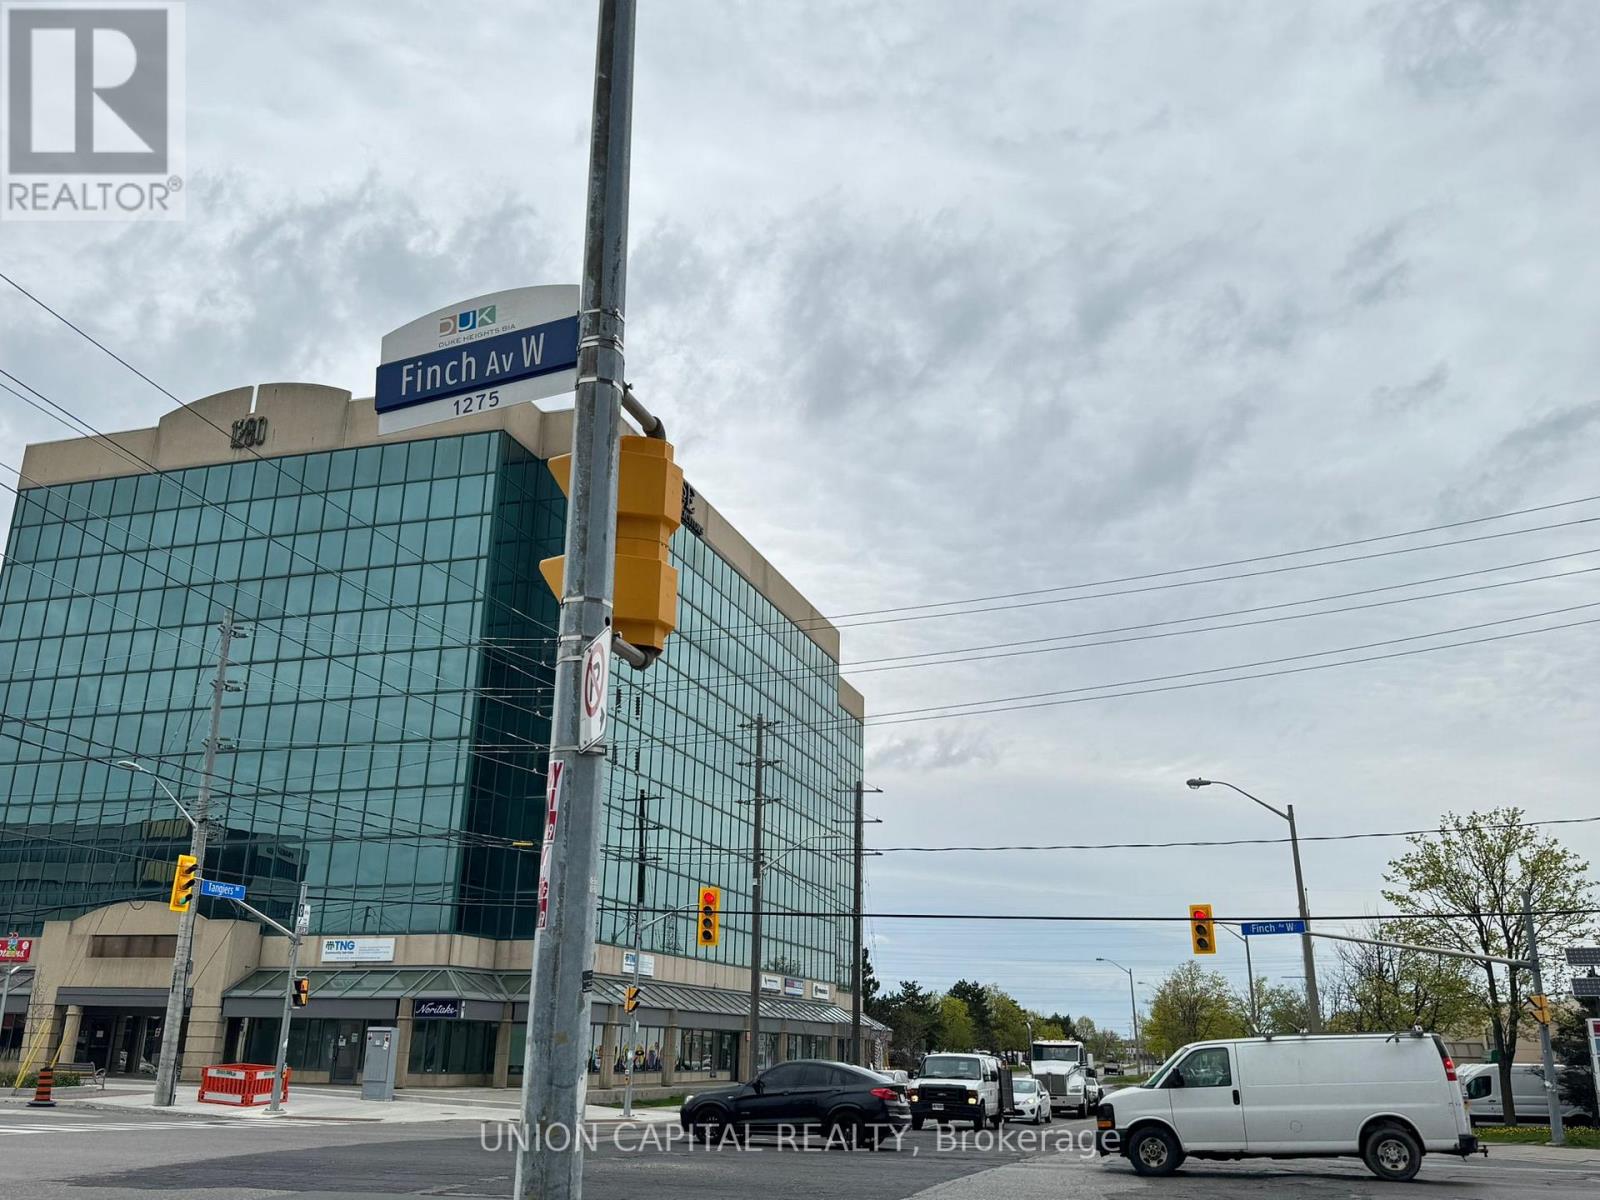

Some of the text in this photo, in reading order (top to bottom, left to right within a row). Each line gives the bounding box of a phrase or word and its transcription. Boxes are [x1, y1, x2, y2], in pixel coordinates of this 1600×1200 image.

[438, 336, 462, 349] DUKE
[463, 327, 500, 342] HEIGHTS
[401, 332, 545, 396] Finch Av W
[453, 390, 499, 415] 1275
[208, 882, 234, 896] Tangiers
[1251, 922, 1276, 933] Finch
[1285, 922, 1294, 932] W
[335, 940, 355, 950] TNG
[416, 1002, 459, 1014] Noritake
